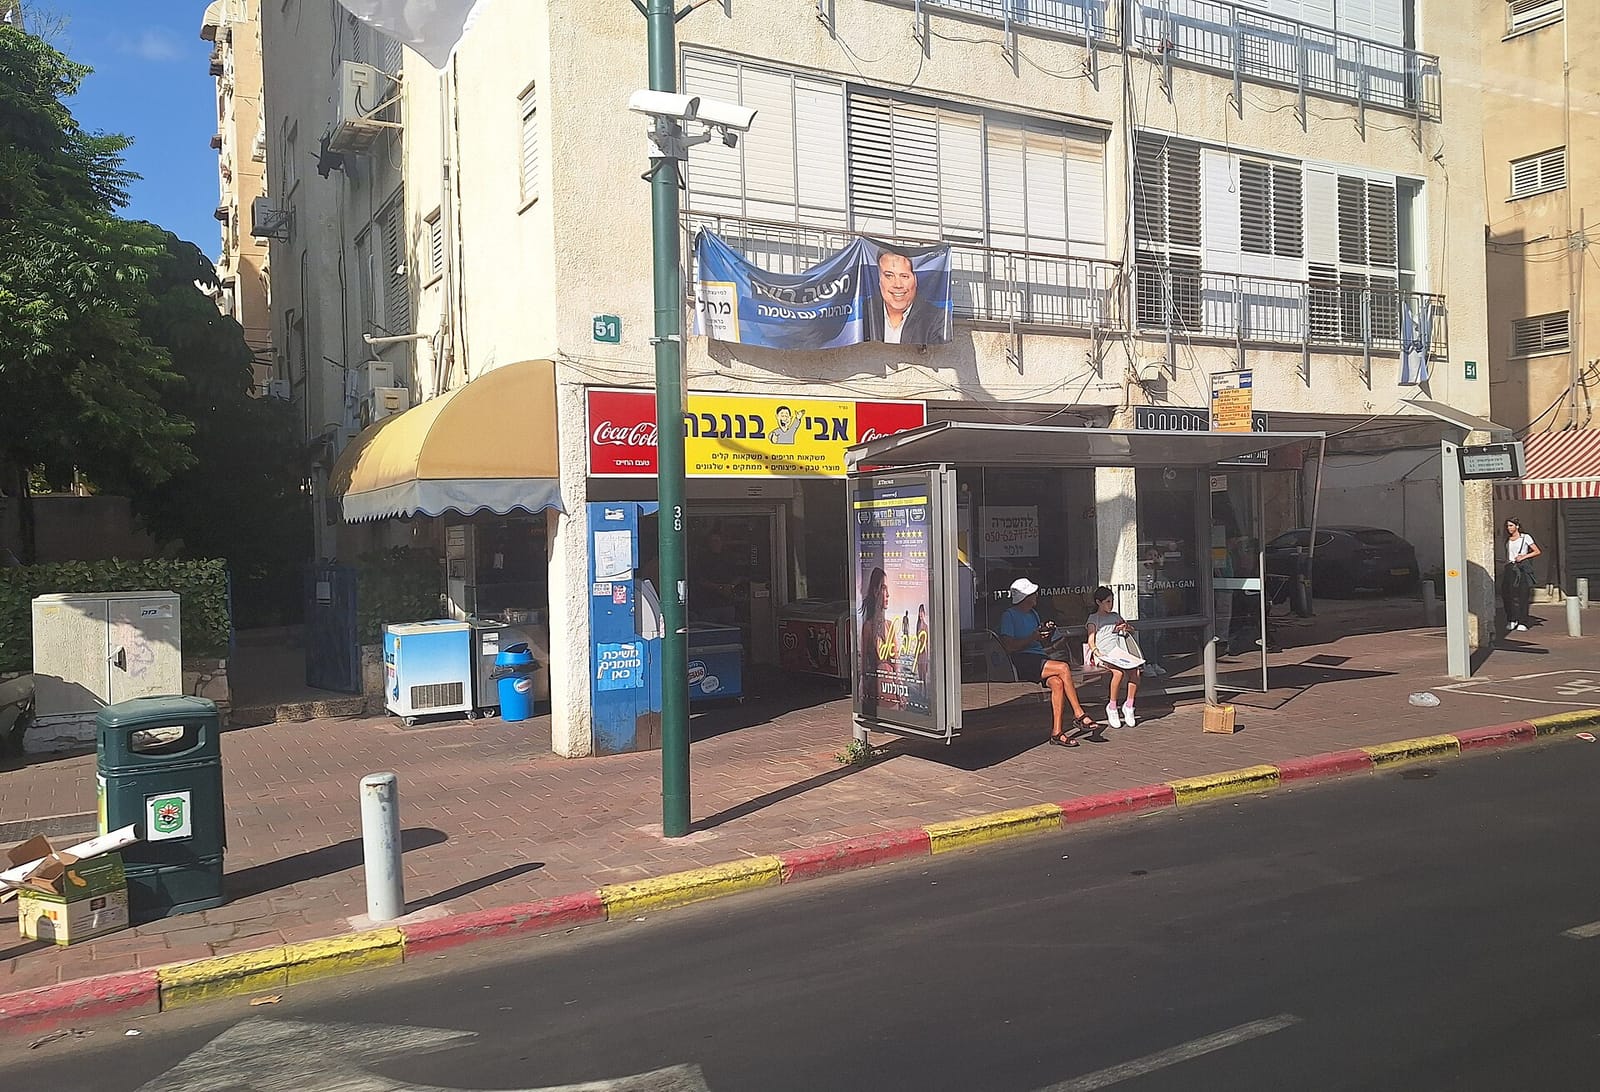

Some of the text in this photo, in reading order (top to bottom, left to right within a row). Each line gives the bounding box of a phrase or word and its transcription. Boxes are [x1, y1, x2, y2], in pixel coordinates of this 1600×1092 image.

[698, 297, 731, 314] מחל
[757, 305, 797, 319] נשמה
[797, 310, 817, 319] עם
[595, 321, 616, 337] 51
[1466, 366, 1475, 376] 51
[684, 412, 766, 439] בנגבה
[804, 416, 849, 441] אבי
[711, 452, 729, 460] קלים
[732, 453, 763, 461] משקאות
[797, 454, 826, 462] משקאות
[992, 513, 1033, 528] להשכרה
[600, 659, 641, 670] מזומנים
[612, 669, 630, 681] כאן
